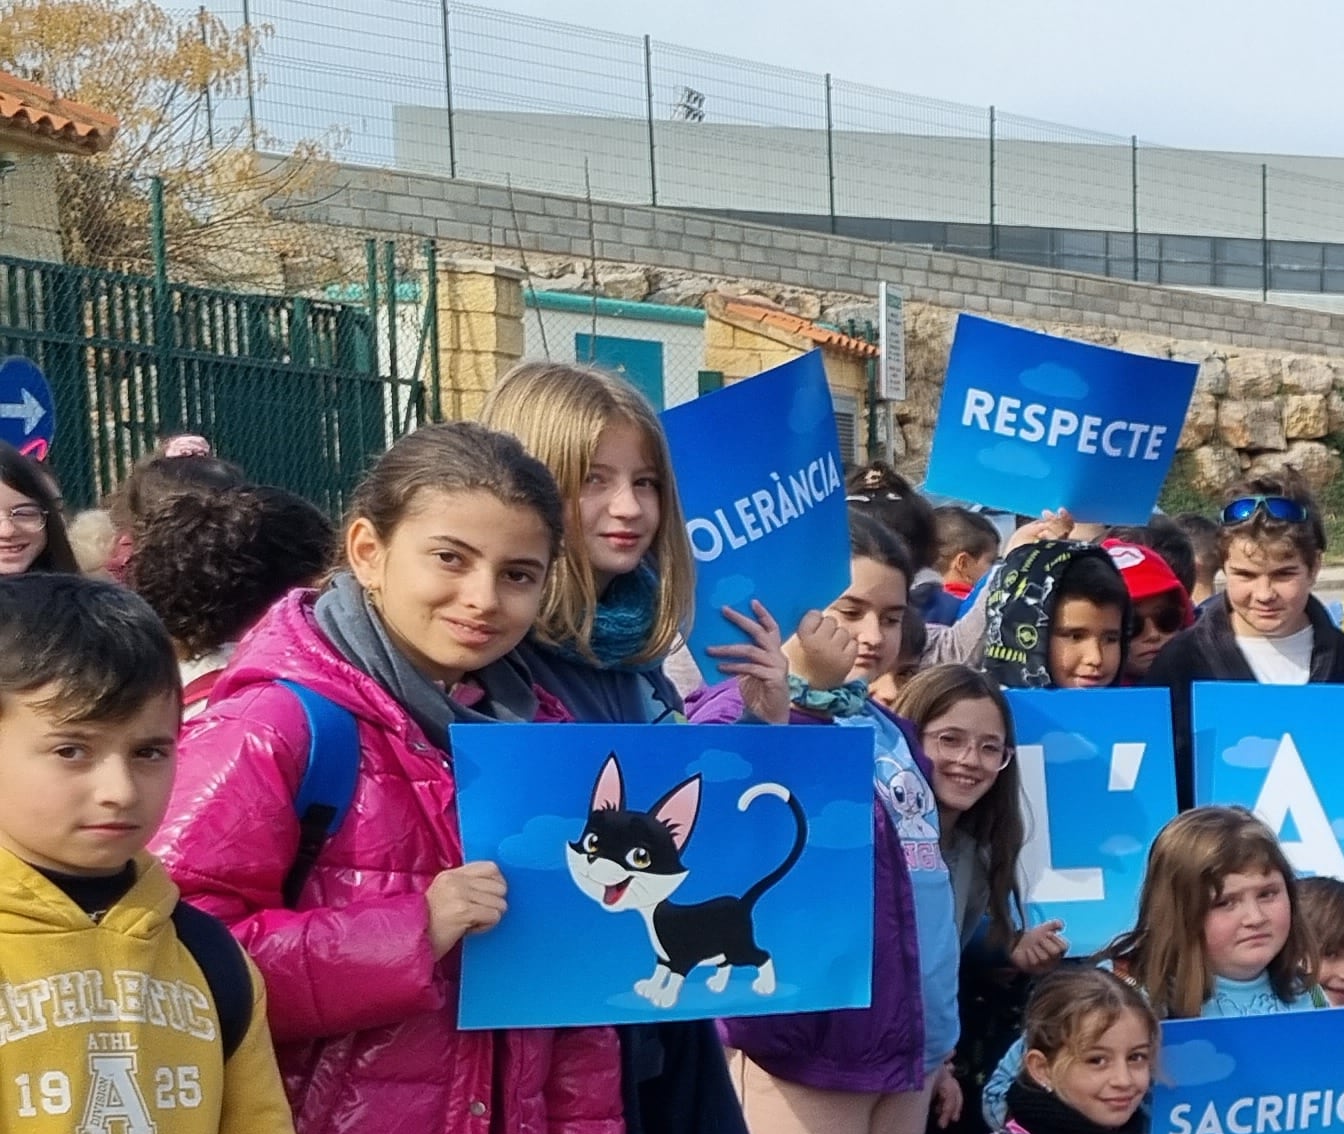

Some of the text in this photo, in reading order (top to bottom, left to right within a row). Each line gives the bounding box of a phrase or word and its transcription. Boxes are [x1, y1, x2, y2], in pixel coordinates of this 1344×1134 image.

[961, 387, 1167, 461] RESPECTE
[685, 450, 841, 562] OLERÀNCIA
[0, 969, 216, 1048] ATHLETIC
[87, 1031, 139, 1051] ATHL
[14, 1069, 73, 1118] 19
[155, 1065, 202, 1110] 25
